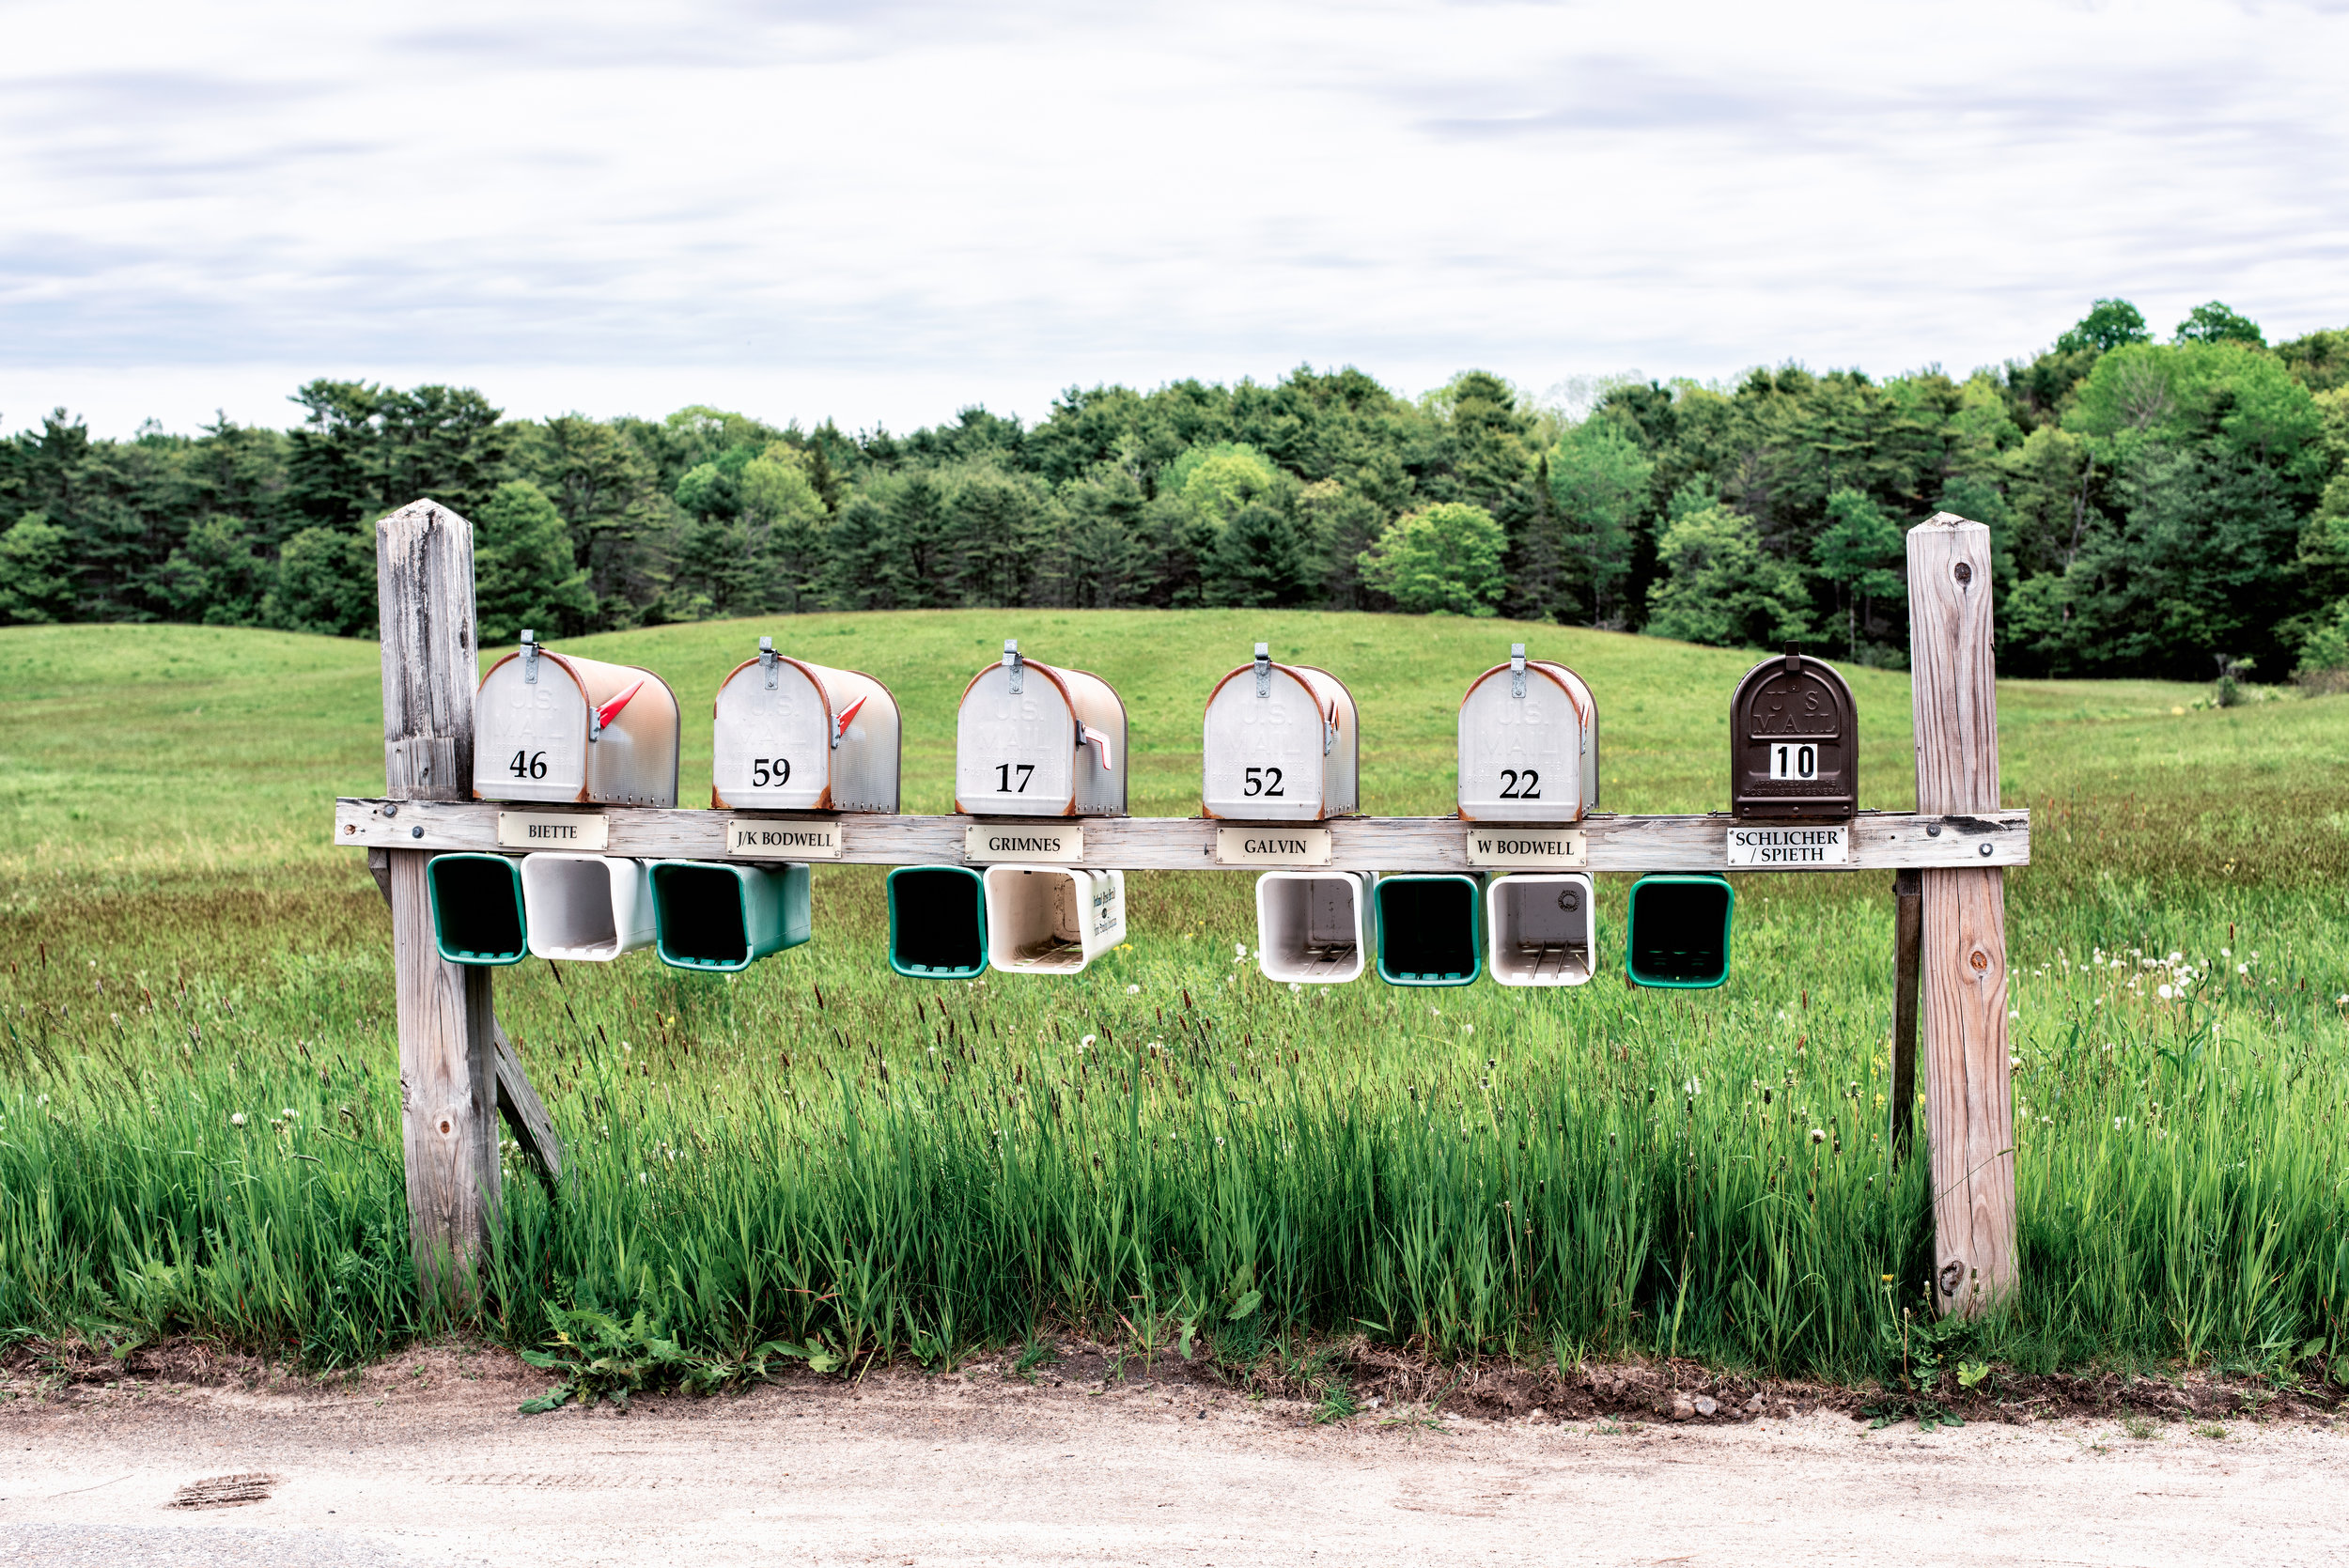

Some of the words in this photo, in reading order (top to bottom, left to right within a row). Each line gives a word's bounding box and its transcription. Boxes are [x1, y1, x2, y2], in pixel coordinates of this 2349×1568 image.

[511, 686, 557, 710] U.S.
[994, 699, 1045, 722] U.S.
[1242, 701, 1293, 726] U.S.
[1498, 701, 1549, 726] U.S.
[1752, 713, 1836, 734] MAIL
[493, 714, 564, 739] MAIL
[978, 726, 1052, 752] MAIL
[1225, 730, 1300, 755] MAIL
[1481, 730, 1557, 755] MAIL
[509, 750, 548, 780] 46
[753, 758, 791, 787] 59
[1777, 746, 1814, 778] 10
[995, 763, 1035, 793] 17
[1243, 767, 1284, 797] 52
[1499, 768, 1541, 800] 22
[1745, 787, 1802, 796] POSTMASTER
[1806, 787, 1845, 796] GENERAL
[529, 825, 578, 839] BIETTE
[737, 831, 757, 847] J/K
[762, 831, 833, 846] BODWELL
[1735, 831, 1839, 846] SCHLICHER
[988, 837, 1061, 853] GRIMNES
[1243, 839, 1307, 854] GALVIN
[1477, 840, 1492, 853] W
[1497, 840, 1575, 855] BODWELL
[1750, 847, 1757, 863] /
[1761, 847, 1824, 862] SPIETH
